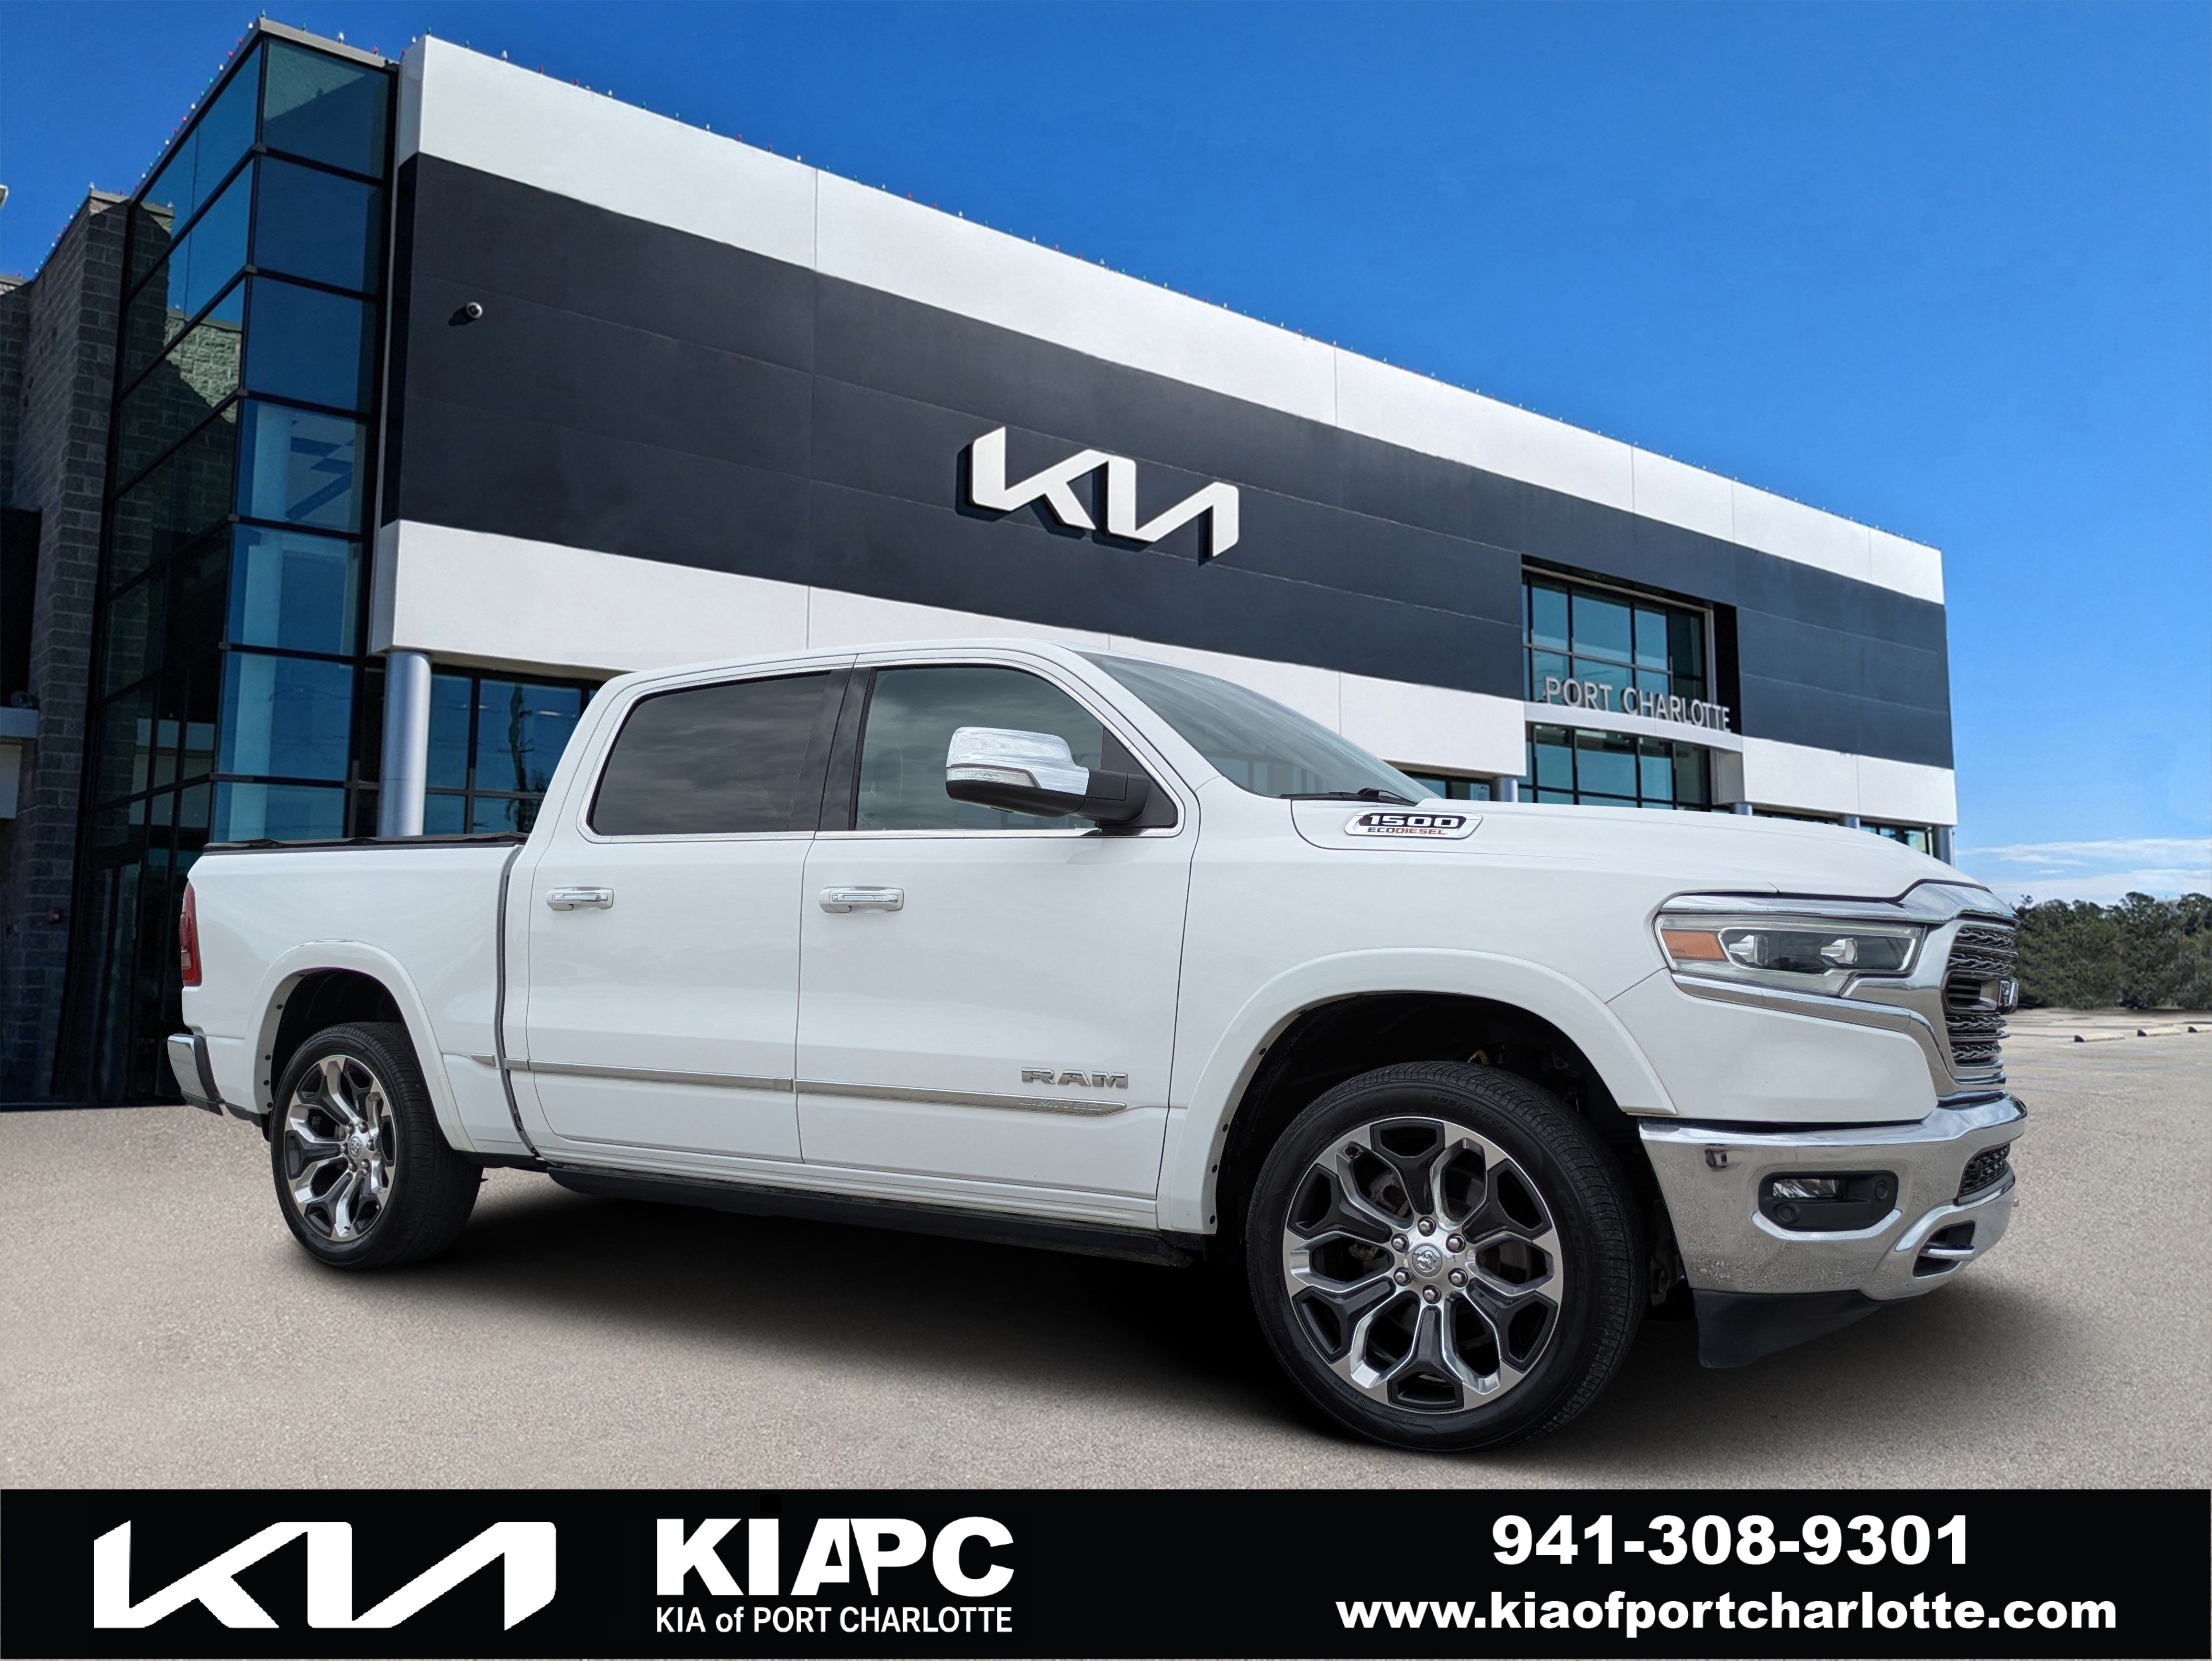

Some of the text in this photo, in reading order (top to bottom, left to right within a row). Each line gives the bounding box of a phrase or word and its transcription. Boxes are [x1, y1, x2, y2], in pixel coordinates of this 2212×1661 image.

[1546, 676, 1731, 733] PORT CHARLOTTE
[1369, 815, 1459, 827] 1500
[1021, 1067, 1128, 1089] RAM
